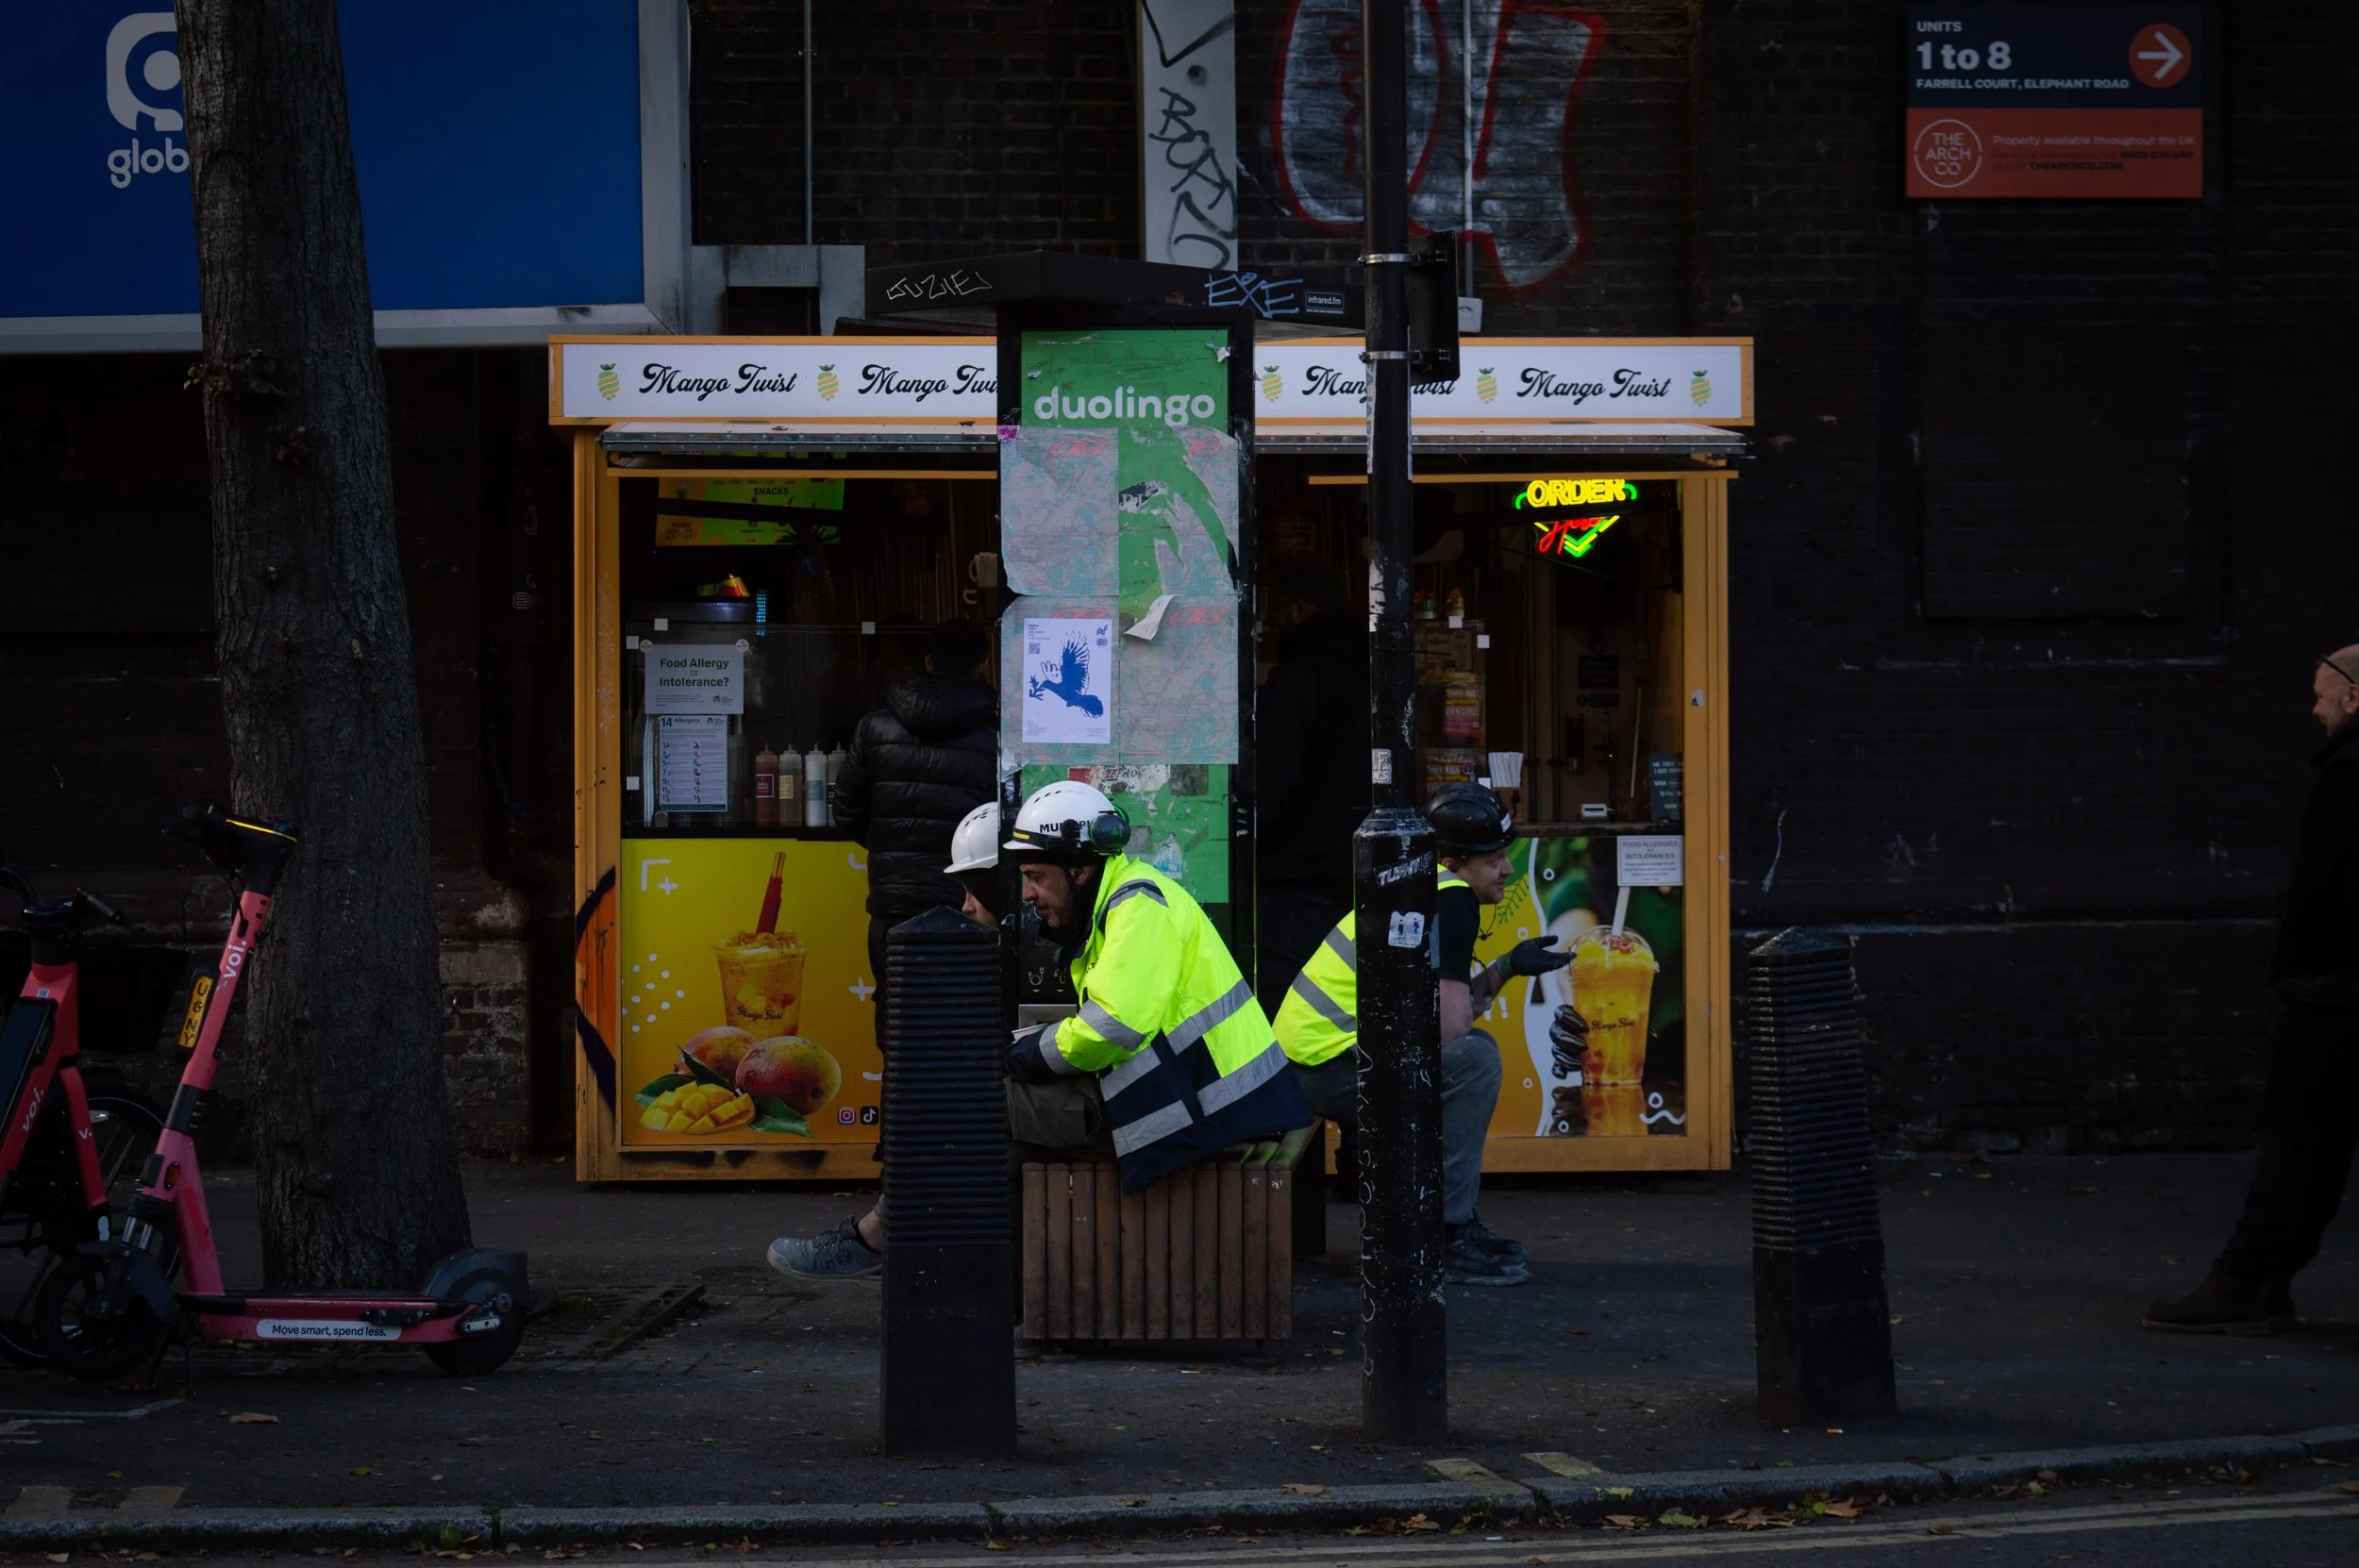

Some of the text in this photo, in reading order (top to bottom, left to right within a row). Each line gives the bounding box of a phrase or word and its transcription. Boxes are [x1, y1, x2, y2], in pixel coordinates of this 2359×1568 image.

[1916, 21, 1963, 33] UNITS
[1916, 41, 2013, 71] 1 to 8
[1916, 78, 2130, 92] FARRELL COURT, ELEPHANT ROAD
[1932, 131, 1965, 146] THE
[1992, 135, 2196, 146] Property available throughout the UK
[1924, 146, 1972, 160] ARCH
[1933, 161, 1963, 176] CO
[1307, 295, 1342, 305] infrared.fm
[639, 362, 797, 402] Mango Twist
[858, 363, 997, 402] Mango Twi
[1301, 365, 1367, 402] Man
[1516, 367, 1670, 406] Mango Twist
[1033, 385, 1215, 426] duolingo
[753, 486, 790, 496] SNACKS
[1527, 479, 1627, 508] ORDER
[661, 659, 728, 670] Food Allergy
[660, 677, 729, 687] Intolerance?
[661, 718, 673, 726] 14
[223, 941, 247, 978] voi.
[23, 1087, 44, 1132] voi.
[272, 1325, 387, 1337] Move smart, spend less.
